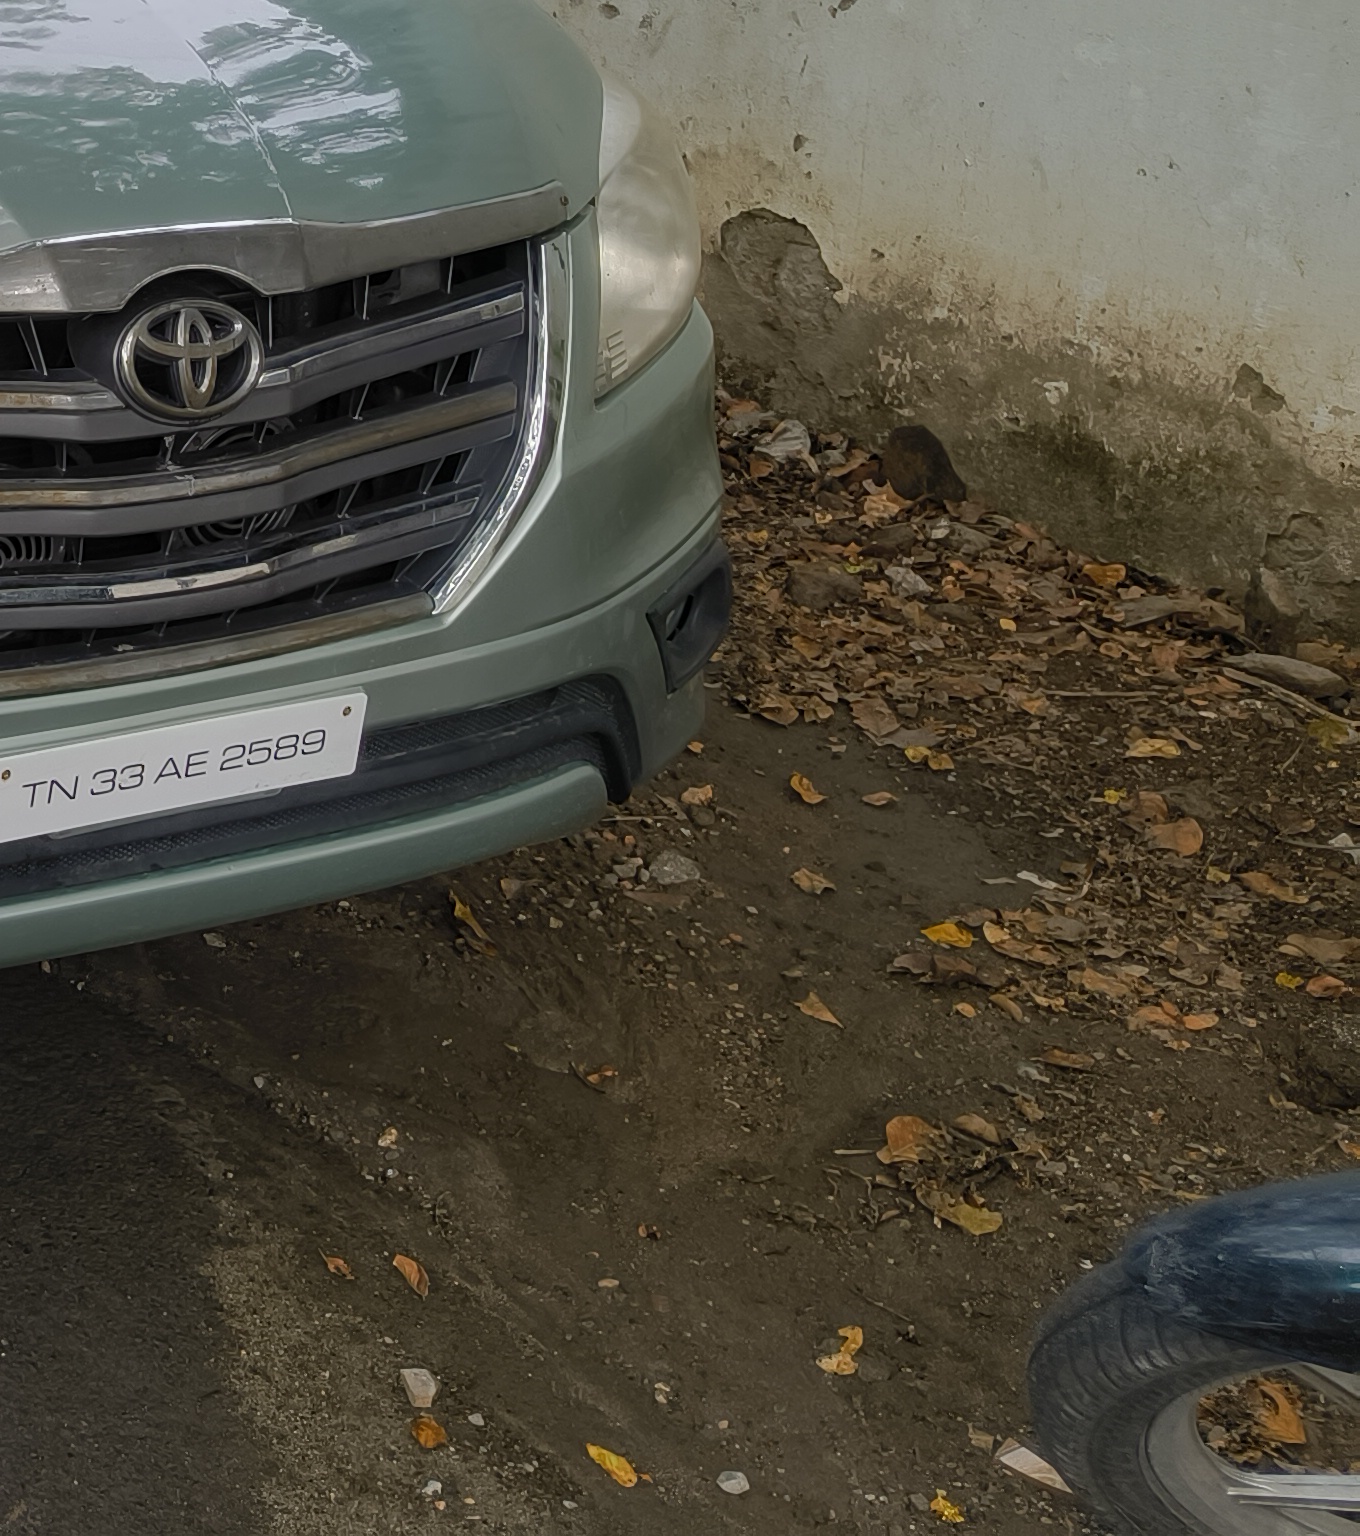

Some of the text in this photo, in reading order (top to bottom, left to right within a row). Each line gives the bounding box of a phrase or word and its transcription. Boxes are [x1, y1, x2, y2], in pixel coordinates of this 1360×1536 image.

[22, 729, 327, 808] TN 33 AE 2589
